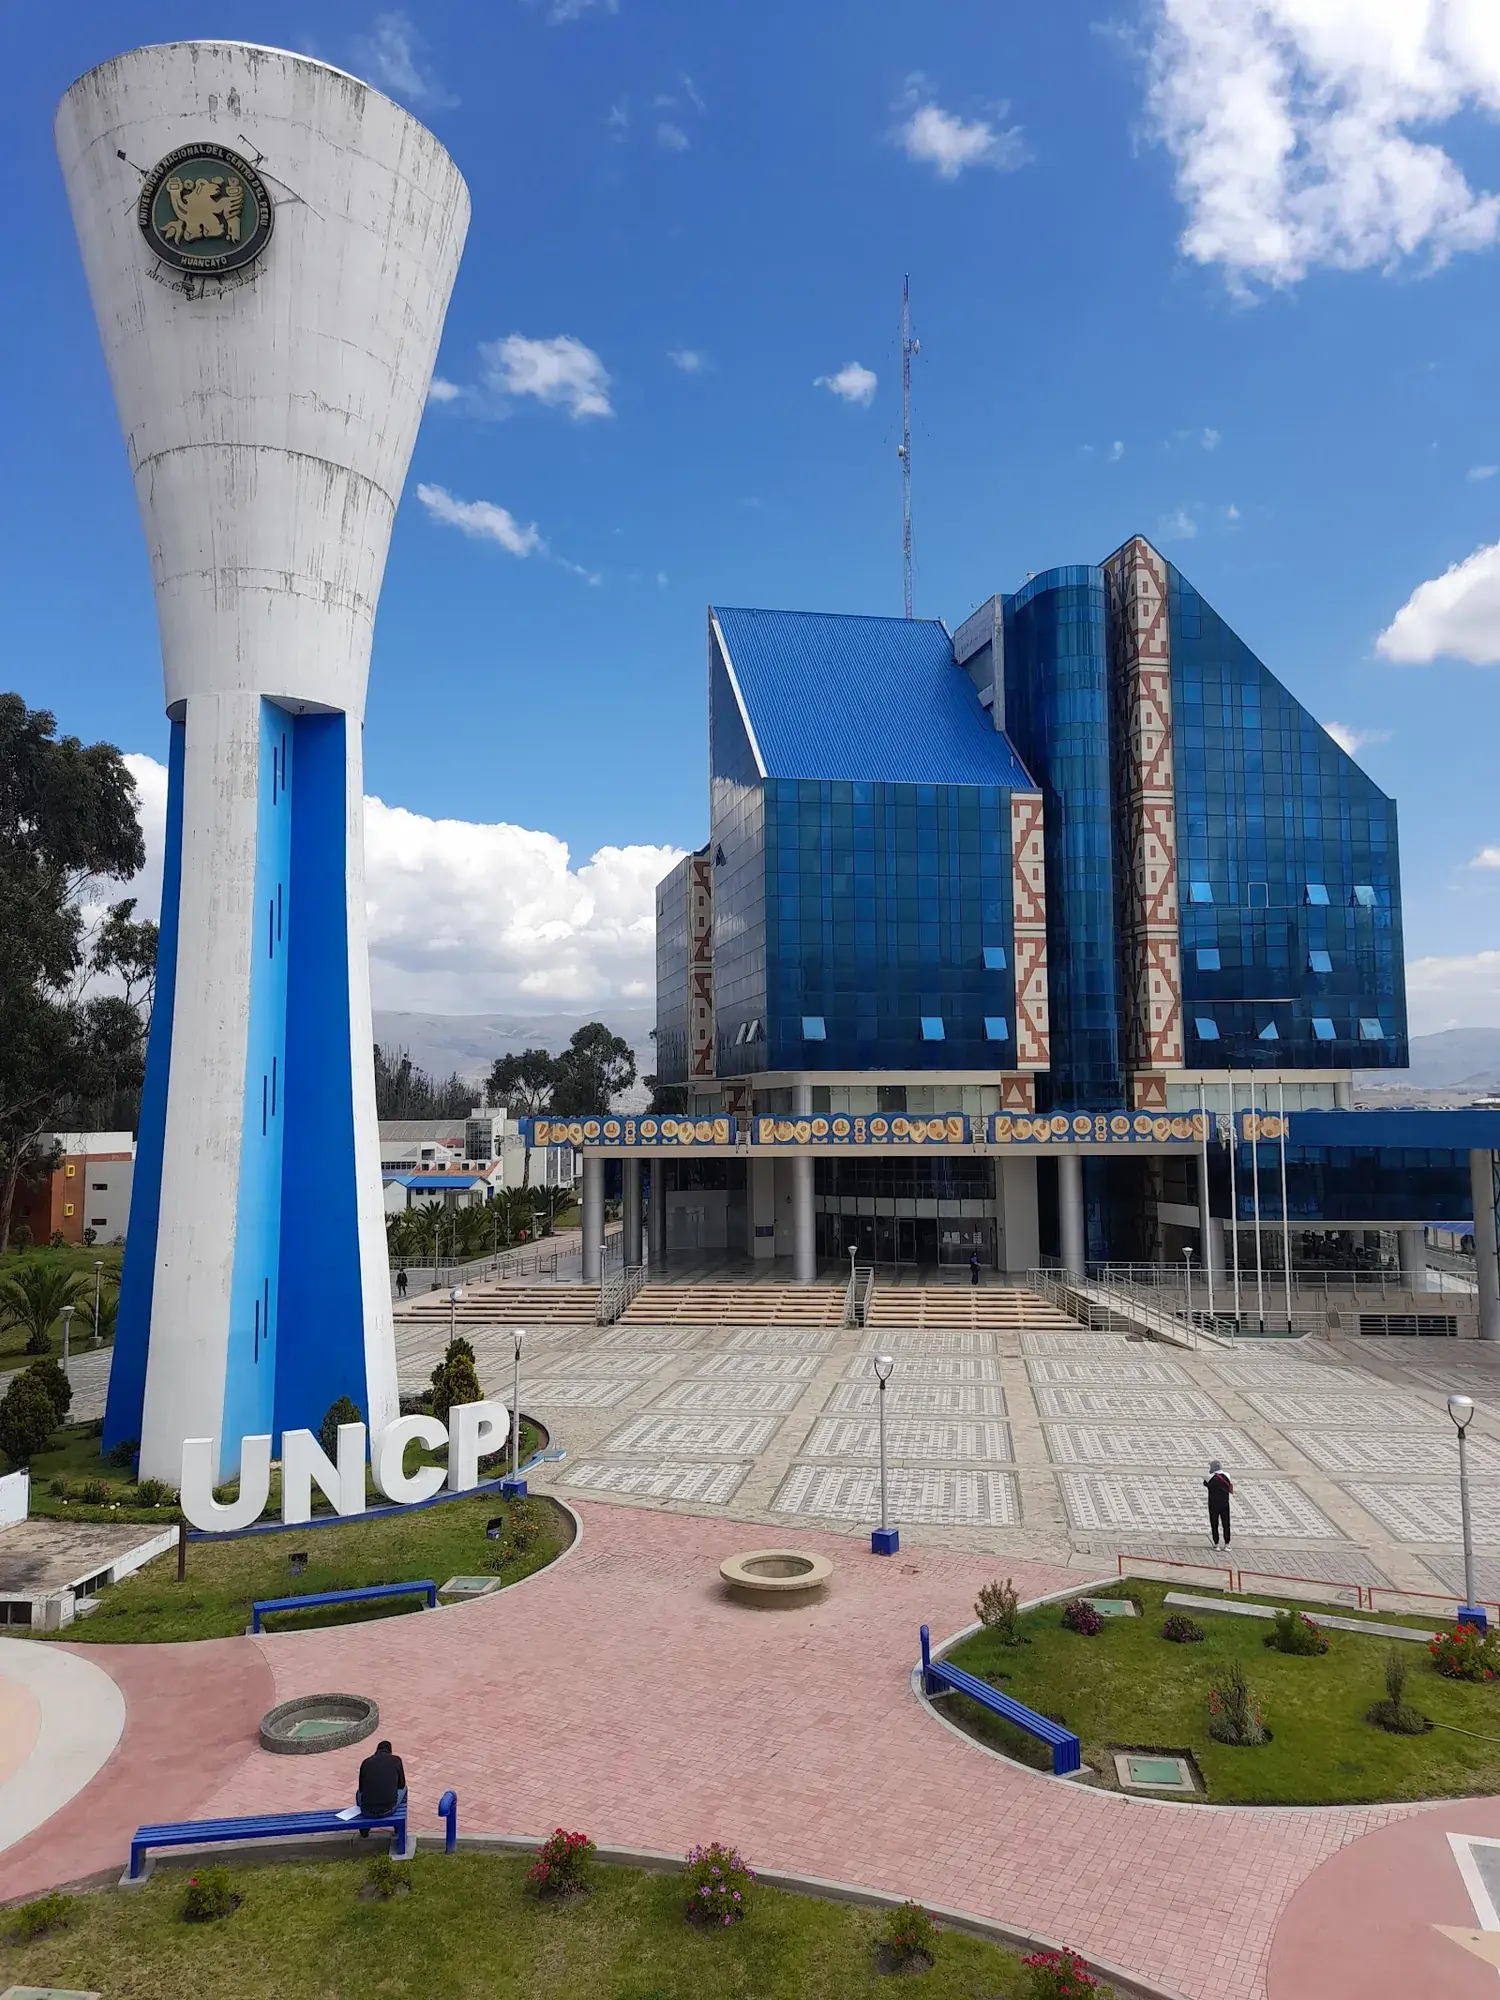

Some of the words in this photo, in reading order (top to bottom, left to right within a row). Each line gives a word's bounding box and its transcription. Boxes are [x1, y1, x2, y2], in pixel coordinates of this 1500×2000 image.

[139, 166, 163, 225] UNIVERSIDAD
[163, 145, 205, 169] NACIONAL
[206, 145, 224, 158] DEL
[226, 152, 255, 181] CENTRO
[252, 180, 265, 200] DEL
[259, 201, 270, 226] PERU
[181, 256, 228, 268] HUANCAYO
[180, 1400, 511, 1532] UNCP
